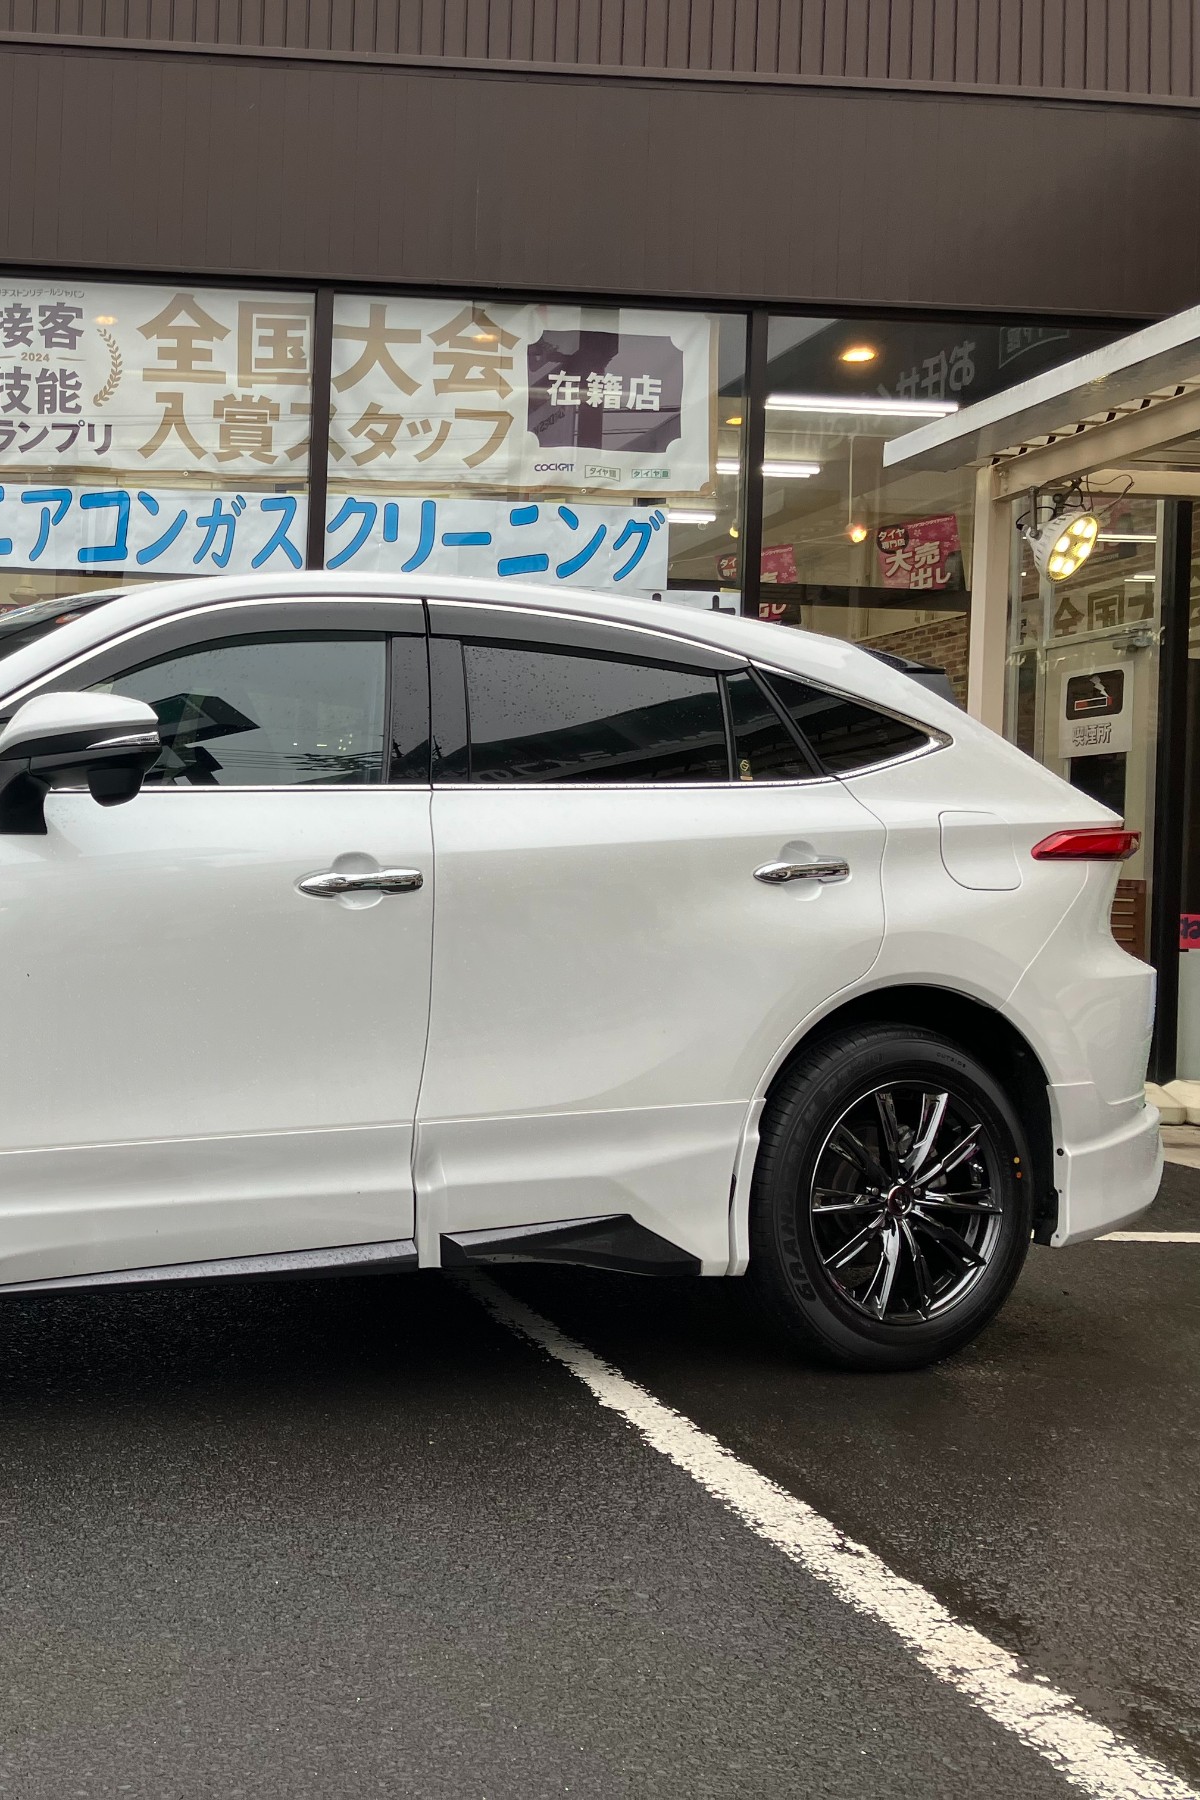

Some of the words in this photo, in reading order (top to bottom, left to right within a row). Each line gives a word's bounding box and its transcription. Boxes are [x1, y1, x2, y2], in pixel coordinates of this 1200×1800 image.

[21, 352, 50, 362] 2024
[547, 370, 663, 411] 在籍店
[534, 463, 575, 472] COCKPIT
[878, 528, 905, 541] タイヤ
[882, 538, 906, 549] 専門店
[720, 557, 737, 568] タイ
[885, 541, 940, 577] 大売
[910, 567, 952, 590] 出し
